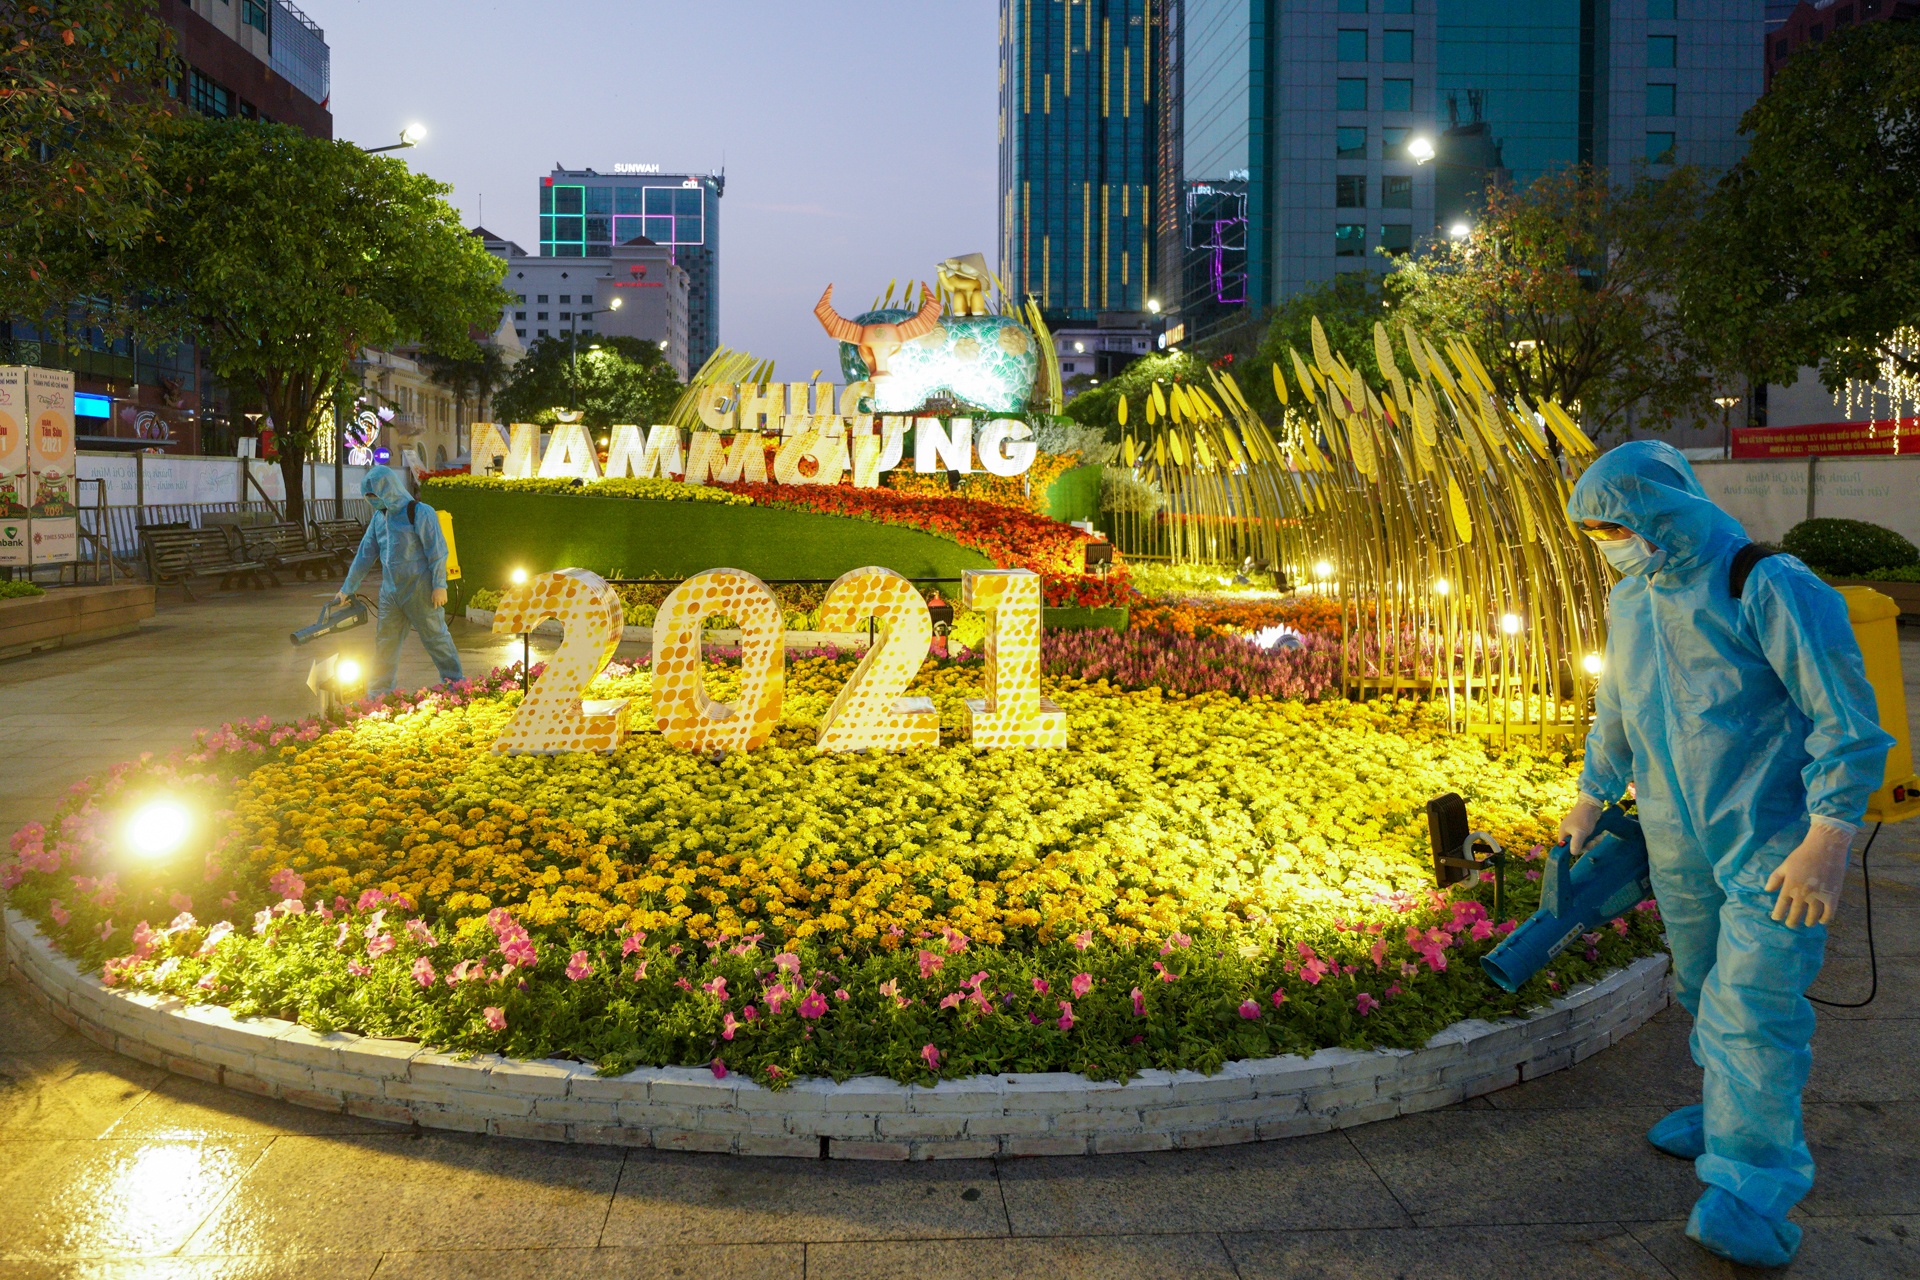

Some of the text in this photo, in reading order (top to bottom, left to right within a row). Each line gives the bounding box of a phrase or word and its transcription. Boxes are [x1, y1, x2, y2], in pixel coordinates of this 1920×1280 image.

[614, 163, 659, 173] SUNWAH
[682, 179, 698, 189] citi
[698, 369, 876, 430] CHÚC
[42, 437, 62, 453] 2021
[471, 411, 687, 478] NĂM
[45, 506, 64, 516] 2021
[58, 532, 75, 540] SQUARE
[0, 539, 24, 547] bank
[492, 566, 1067, 754] 2021
